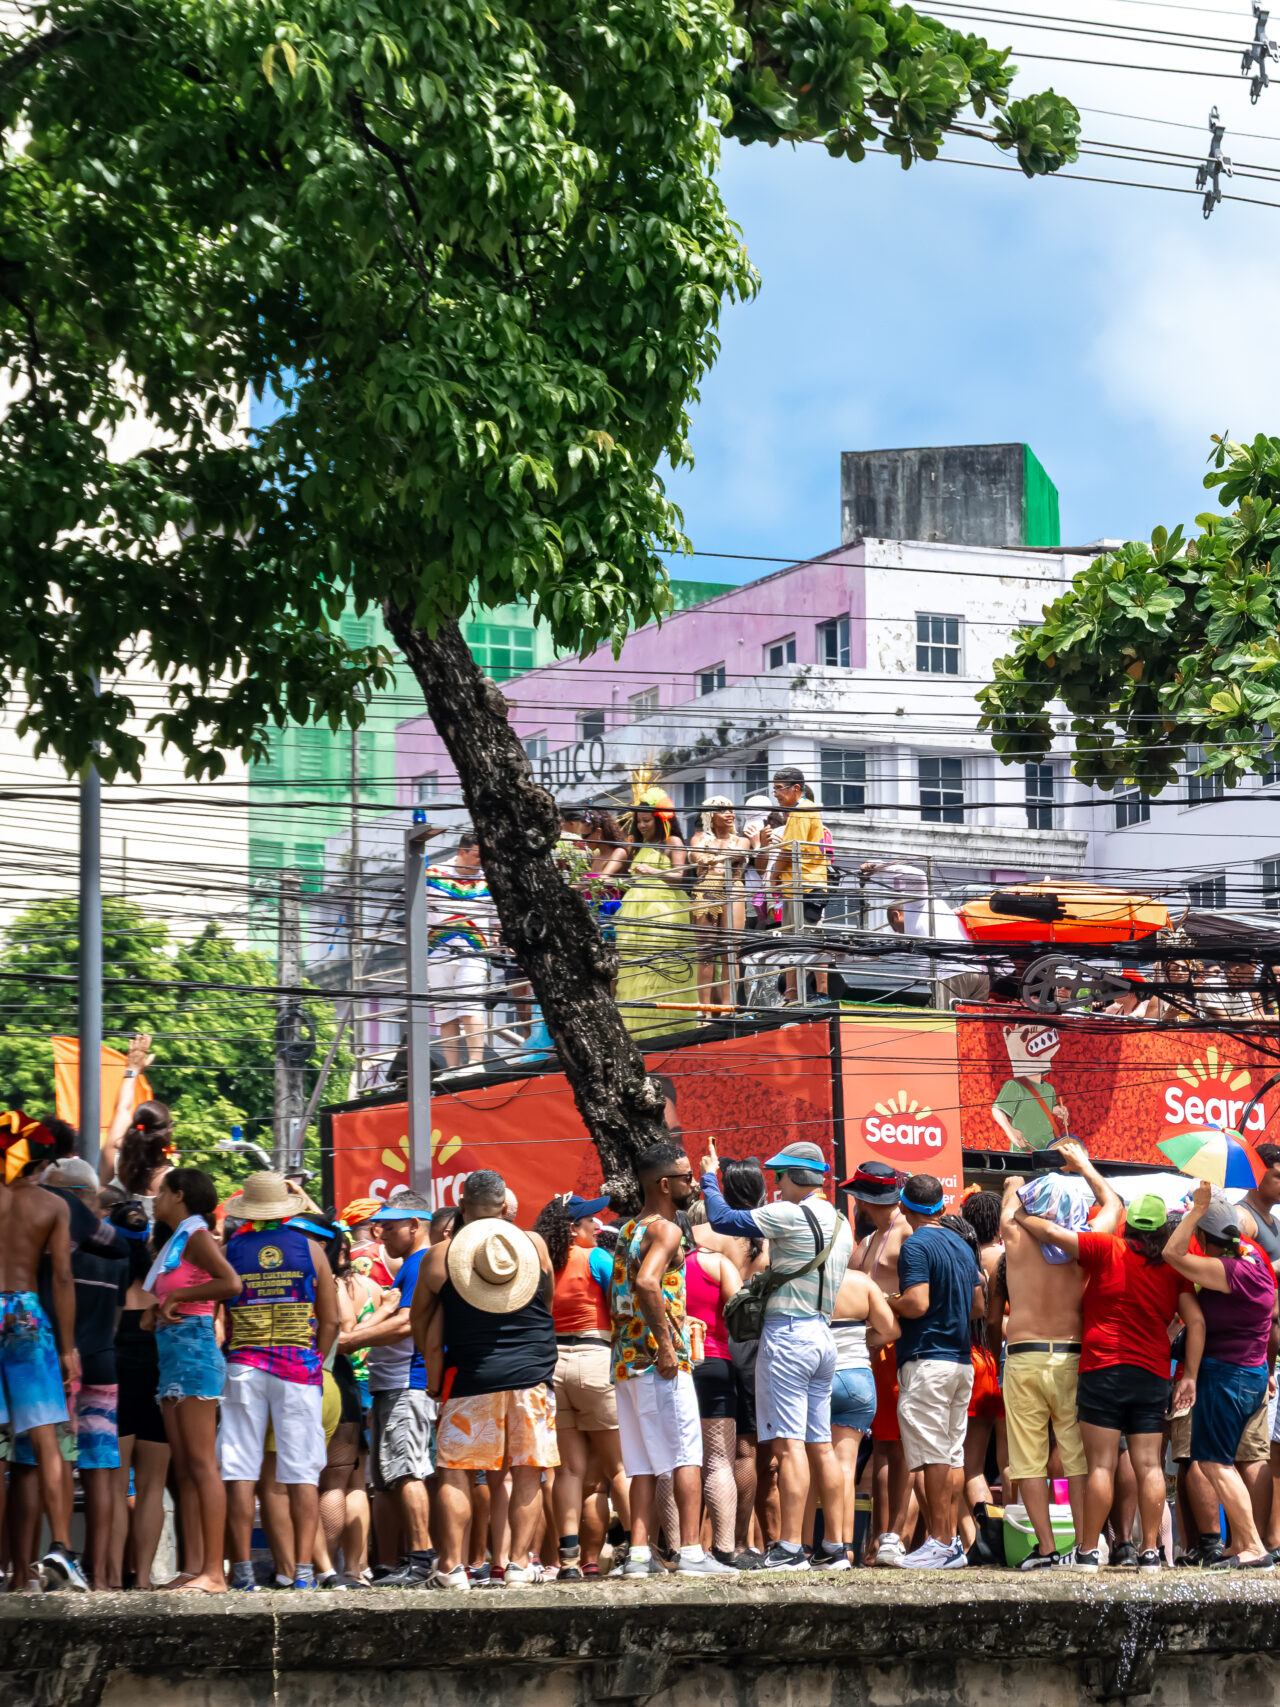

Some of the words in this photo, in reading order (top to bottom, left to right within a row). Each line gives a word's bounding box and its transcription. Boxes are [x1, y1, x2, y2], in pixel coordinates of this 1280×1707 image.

[529, 736, 604, 793] BUCO
[1164, 1087, 1266, 1131] Seara
[866, 1116, 942, 1147] Seara
